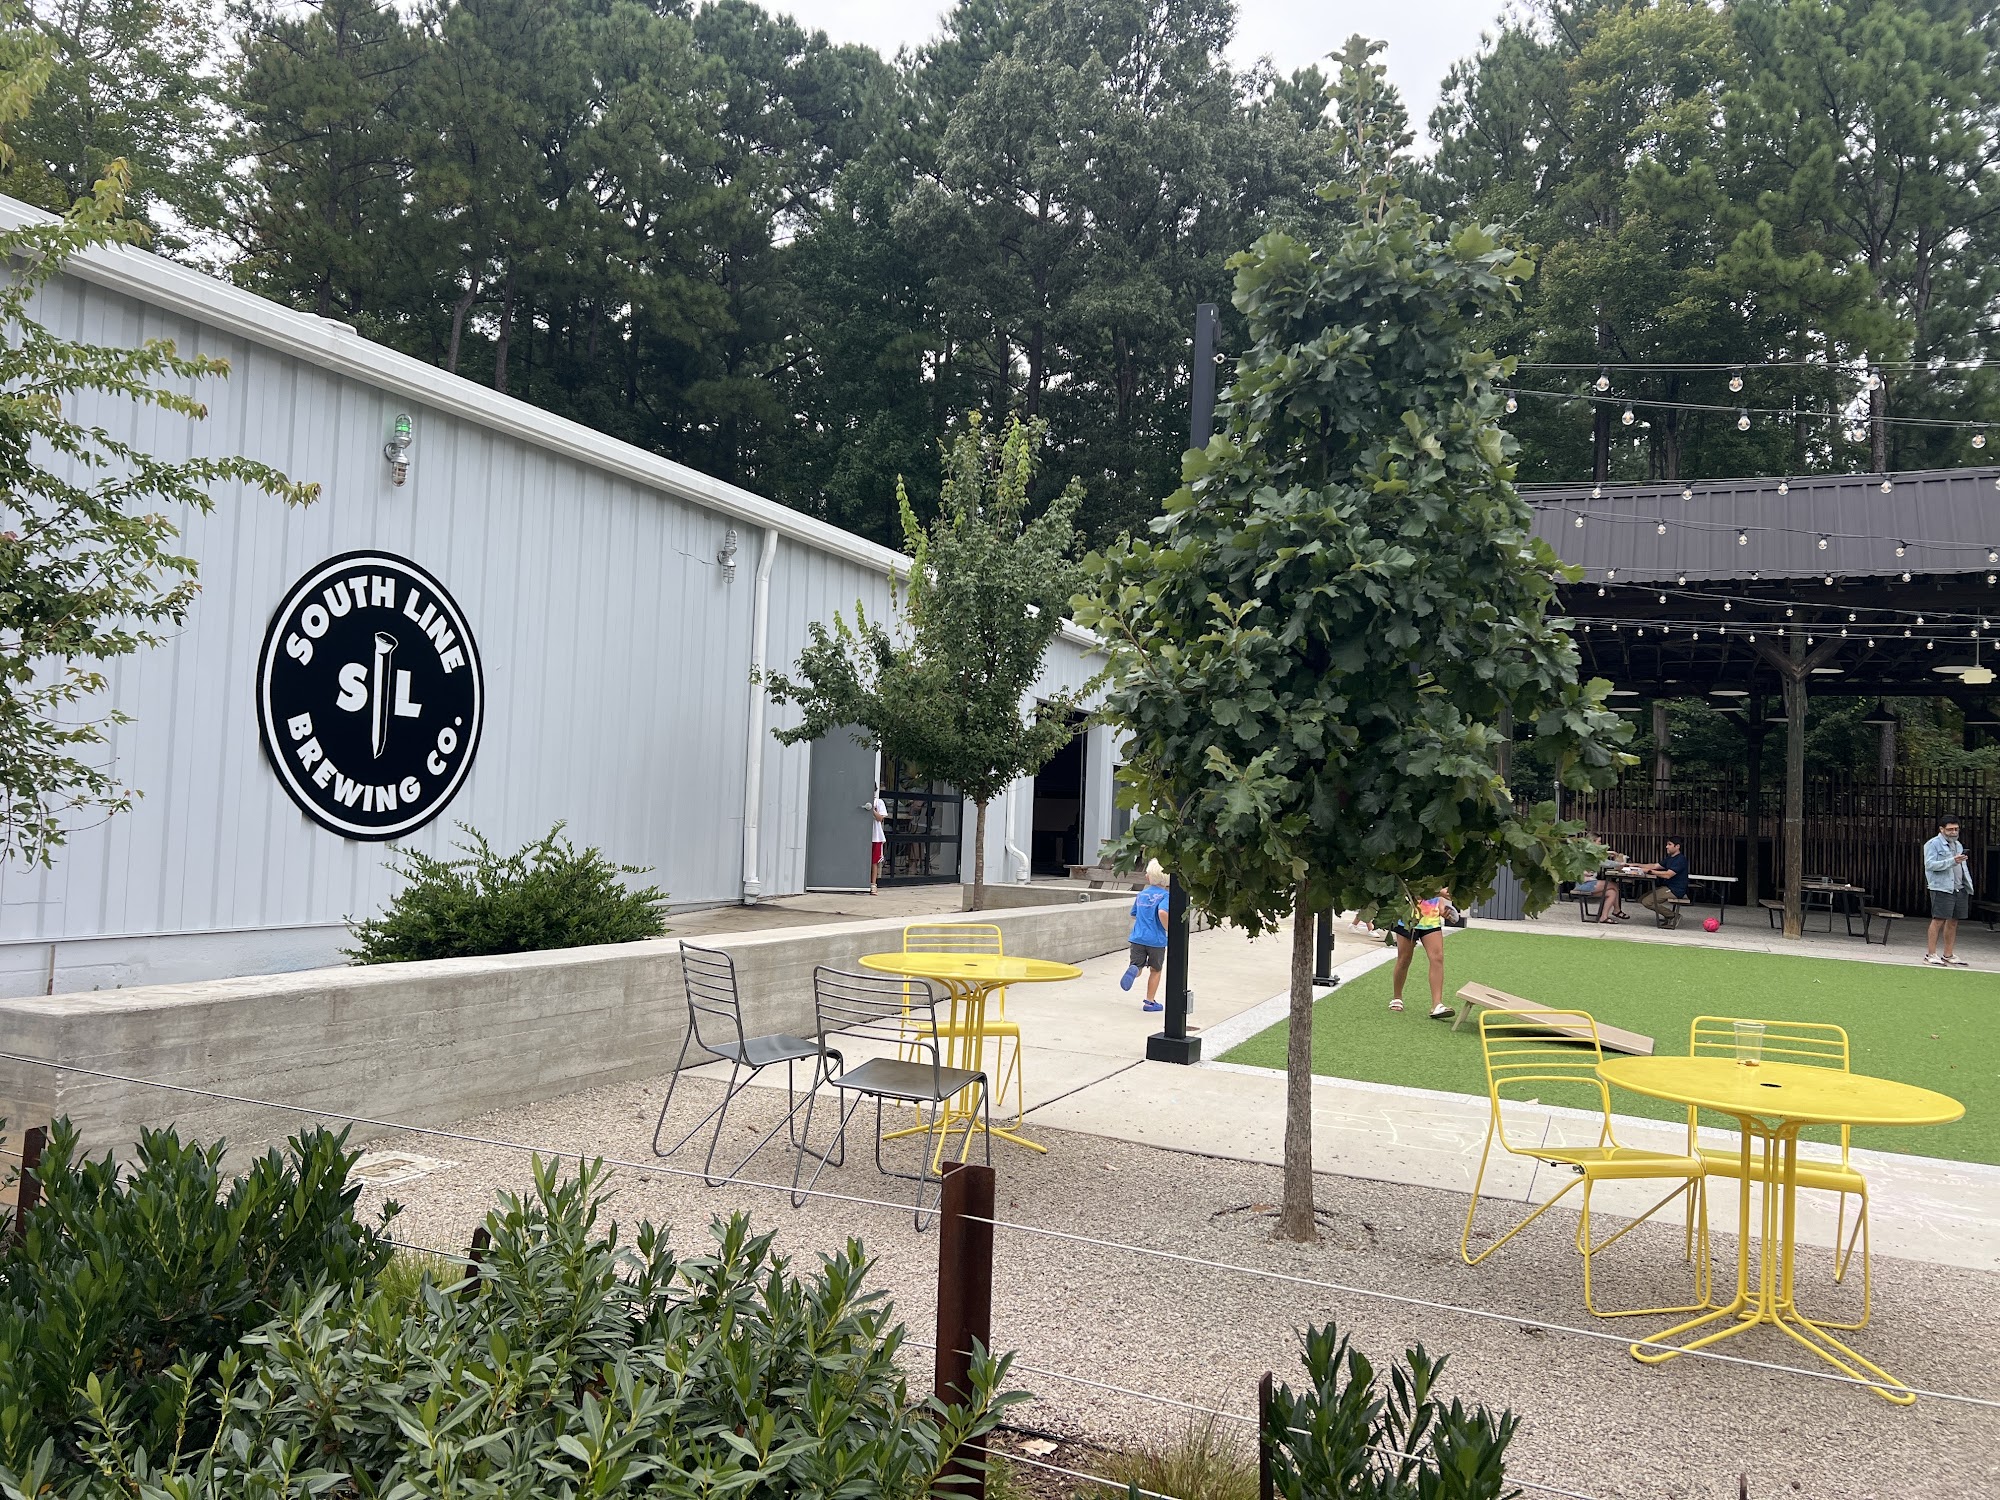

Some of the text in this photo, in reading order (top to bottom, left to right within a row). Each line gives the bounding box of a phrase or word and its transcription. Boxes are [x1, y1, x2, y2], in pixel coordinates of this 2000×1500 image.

[285, 574, 466, 674] SOUTH LINE
[287, 711, 463, 813] BREWING CO.
